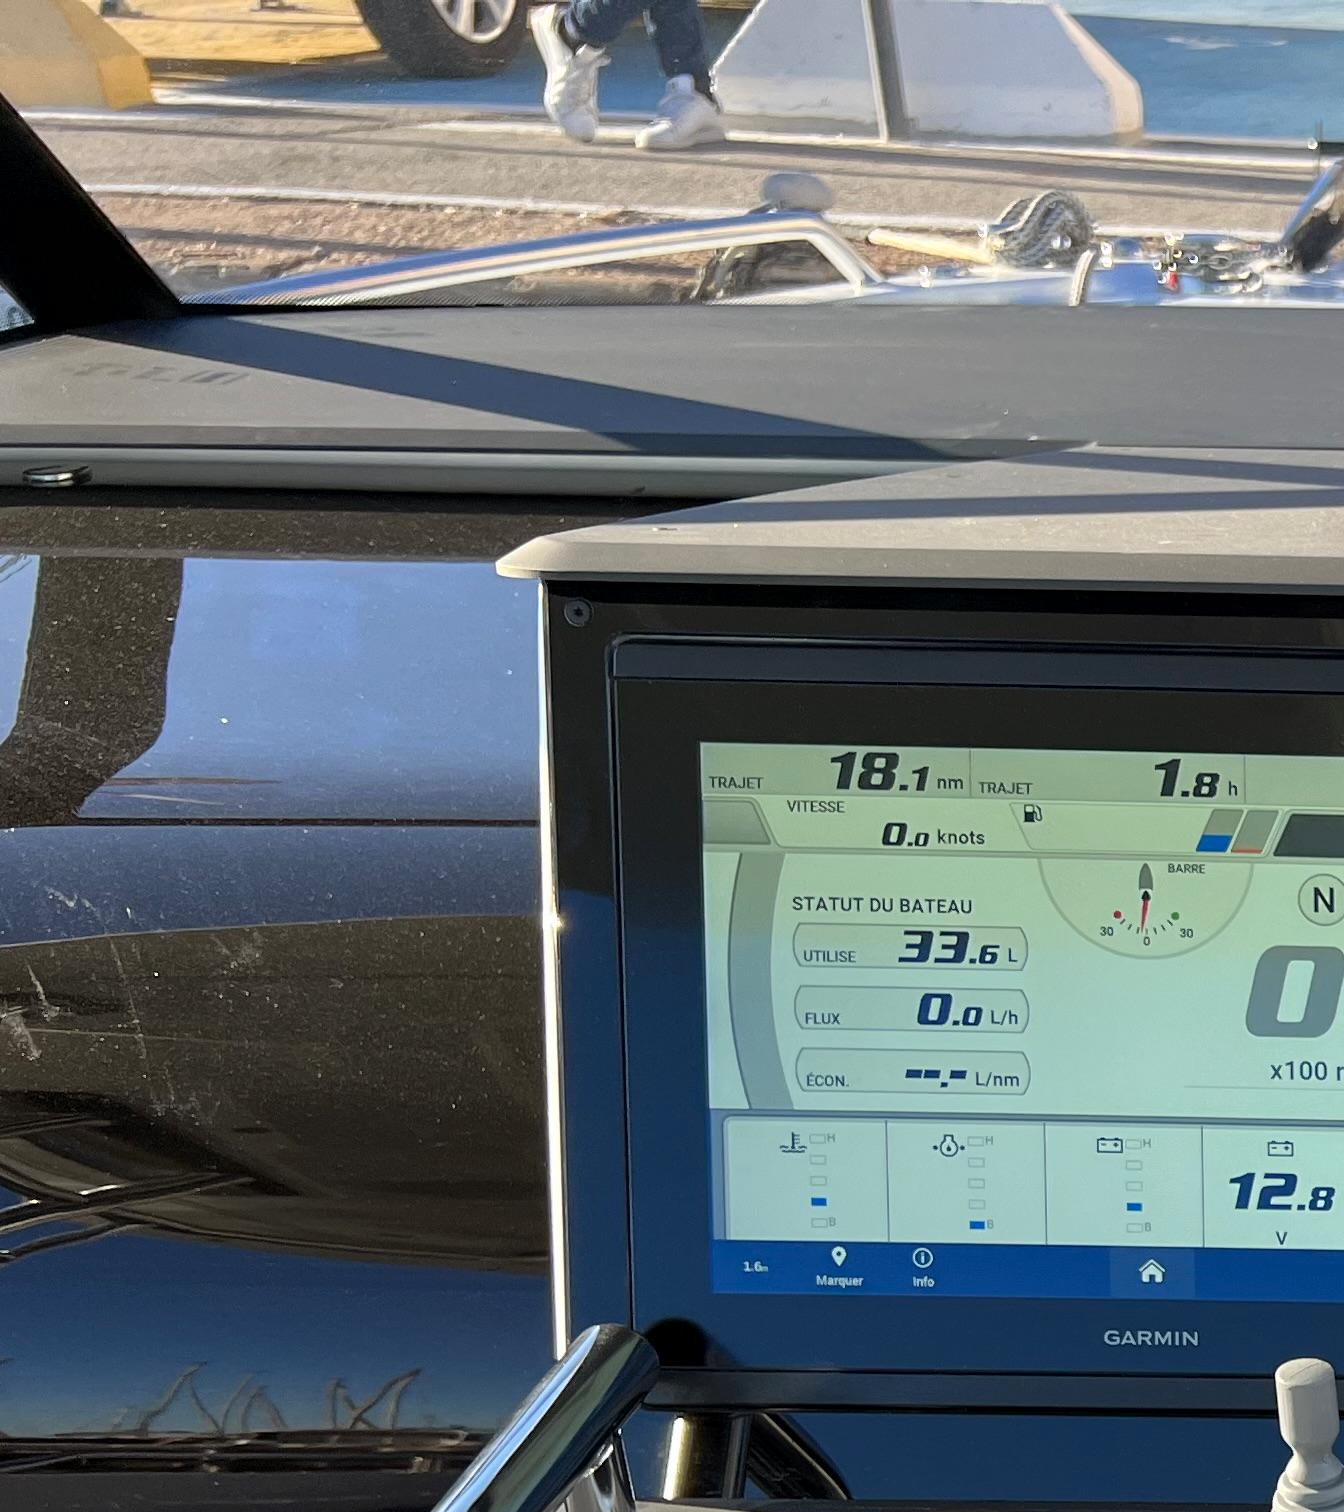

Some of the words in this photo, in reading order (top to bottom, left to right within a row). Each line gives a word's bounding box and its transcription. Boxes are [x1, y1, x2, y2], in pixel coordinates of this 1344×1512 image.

[830, 751, 930, 792] 18.1
[936, 777, 963, 790] nm
[1153, 758, 1220, 798] 1.8
[1228, 781, 1238, 796] h
[709, 776, 763, 790] TRAJET
[978, 781, 1033, 796] TRAJET
[786, 800, 846, 813] VITESSE
[881, 822, 930, 847] 0.0
[936, 829, 985, 846] knots
[1167, 863, 1206, 875] BARRE
[792, 896, 865, 912] STATUT
[869, 897, 894, 913] DU
[899, 898, 973, 915] BATEAU
[1312, 887, 1335, 913] N
[1099, 926, 1114, 937] 30
[1143, 936, 1151, 947] 0
[1179, 927, 1194, 939] 30
[898, 930, 1000, 964] 33.6
[1008, 949, 1018, 964] L
[803, 949, 857, 964] UTILISE
[916, 993, 983, 1026] 0.0
[990, 1010, 1019, 1026] L/h
[805, 1012, 841, 1025] FLUX
[1270, 1060, 1328, 1081] x100
[806, 1071, 850, 1087] ÉCON.
[975, 1071, 1020, 1088] L/nm
[827, 1133, 836, 1143] H
[985, 1136, 994, 1145] H
[1142, 1138, 1152, 1149] H
[1228, 1172, 1336, 1212] 12.8
[1275, 1231, 1288, 1246] V
[815, 1275, 864, 1288] Marquer
[912, 1275, 935, 1288] Info
[1103, 1330, 1199, 1347] GARMIN
